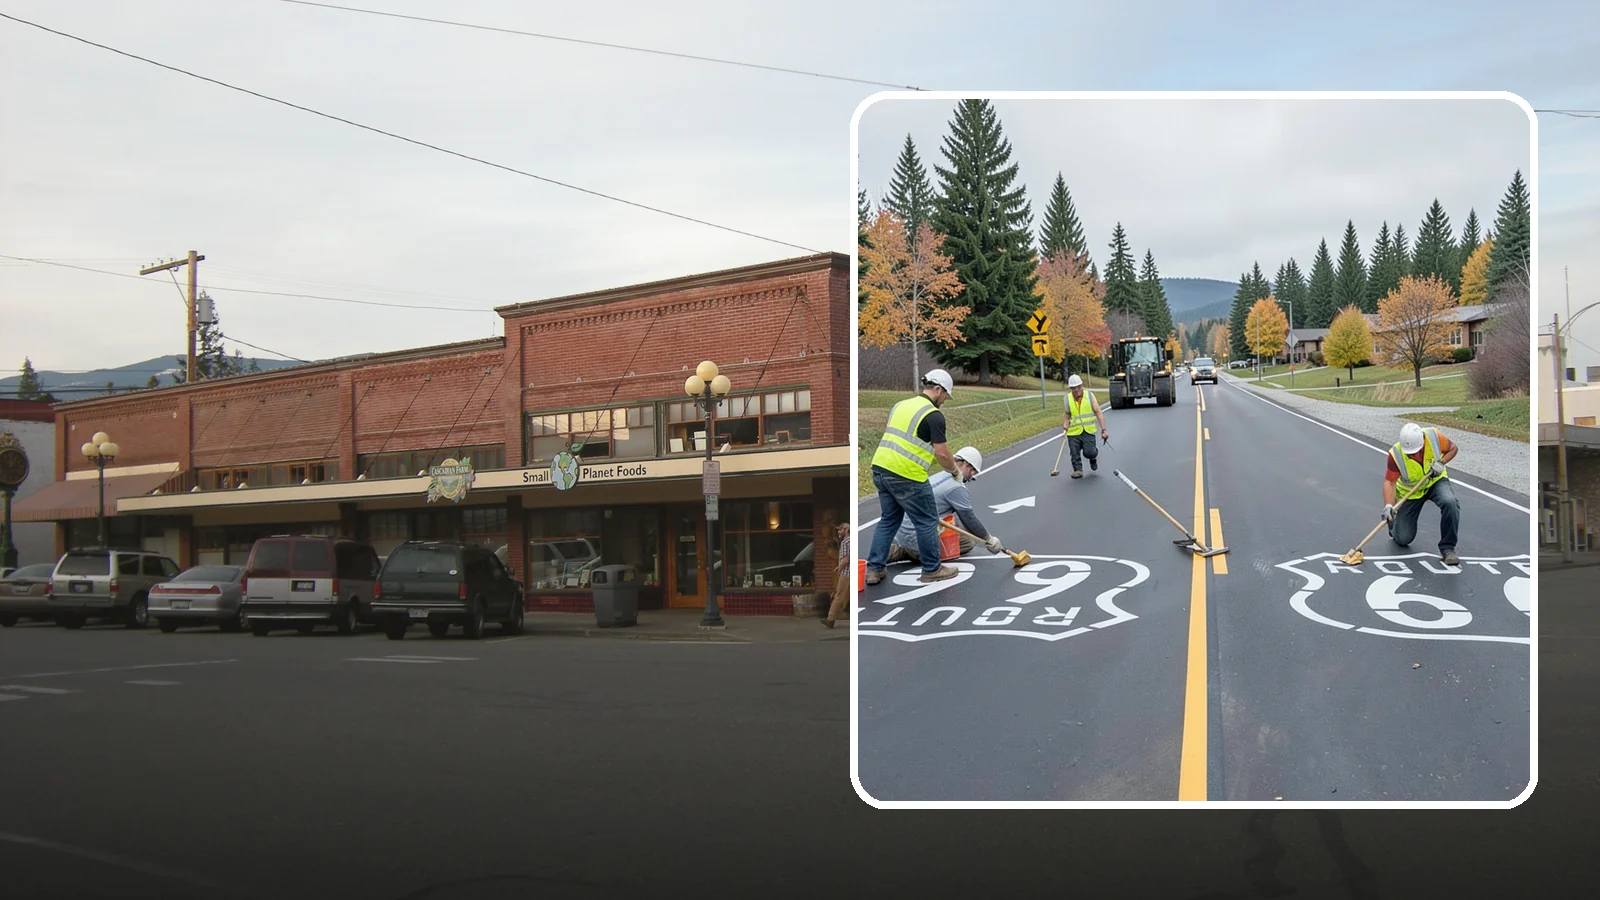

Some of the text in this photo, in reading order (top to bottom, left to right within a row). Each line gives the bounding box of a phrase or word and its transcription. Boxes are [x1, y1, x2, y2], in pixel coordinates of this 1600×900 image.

[523, 464, 647, 483] Small Planet Foods
[1365, 574, 1531, 630] 6
[858, 606, 1082, 627] ROUT
